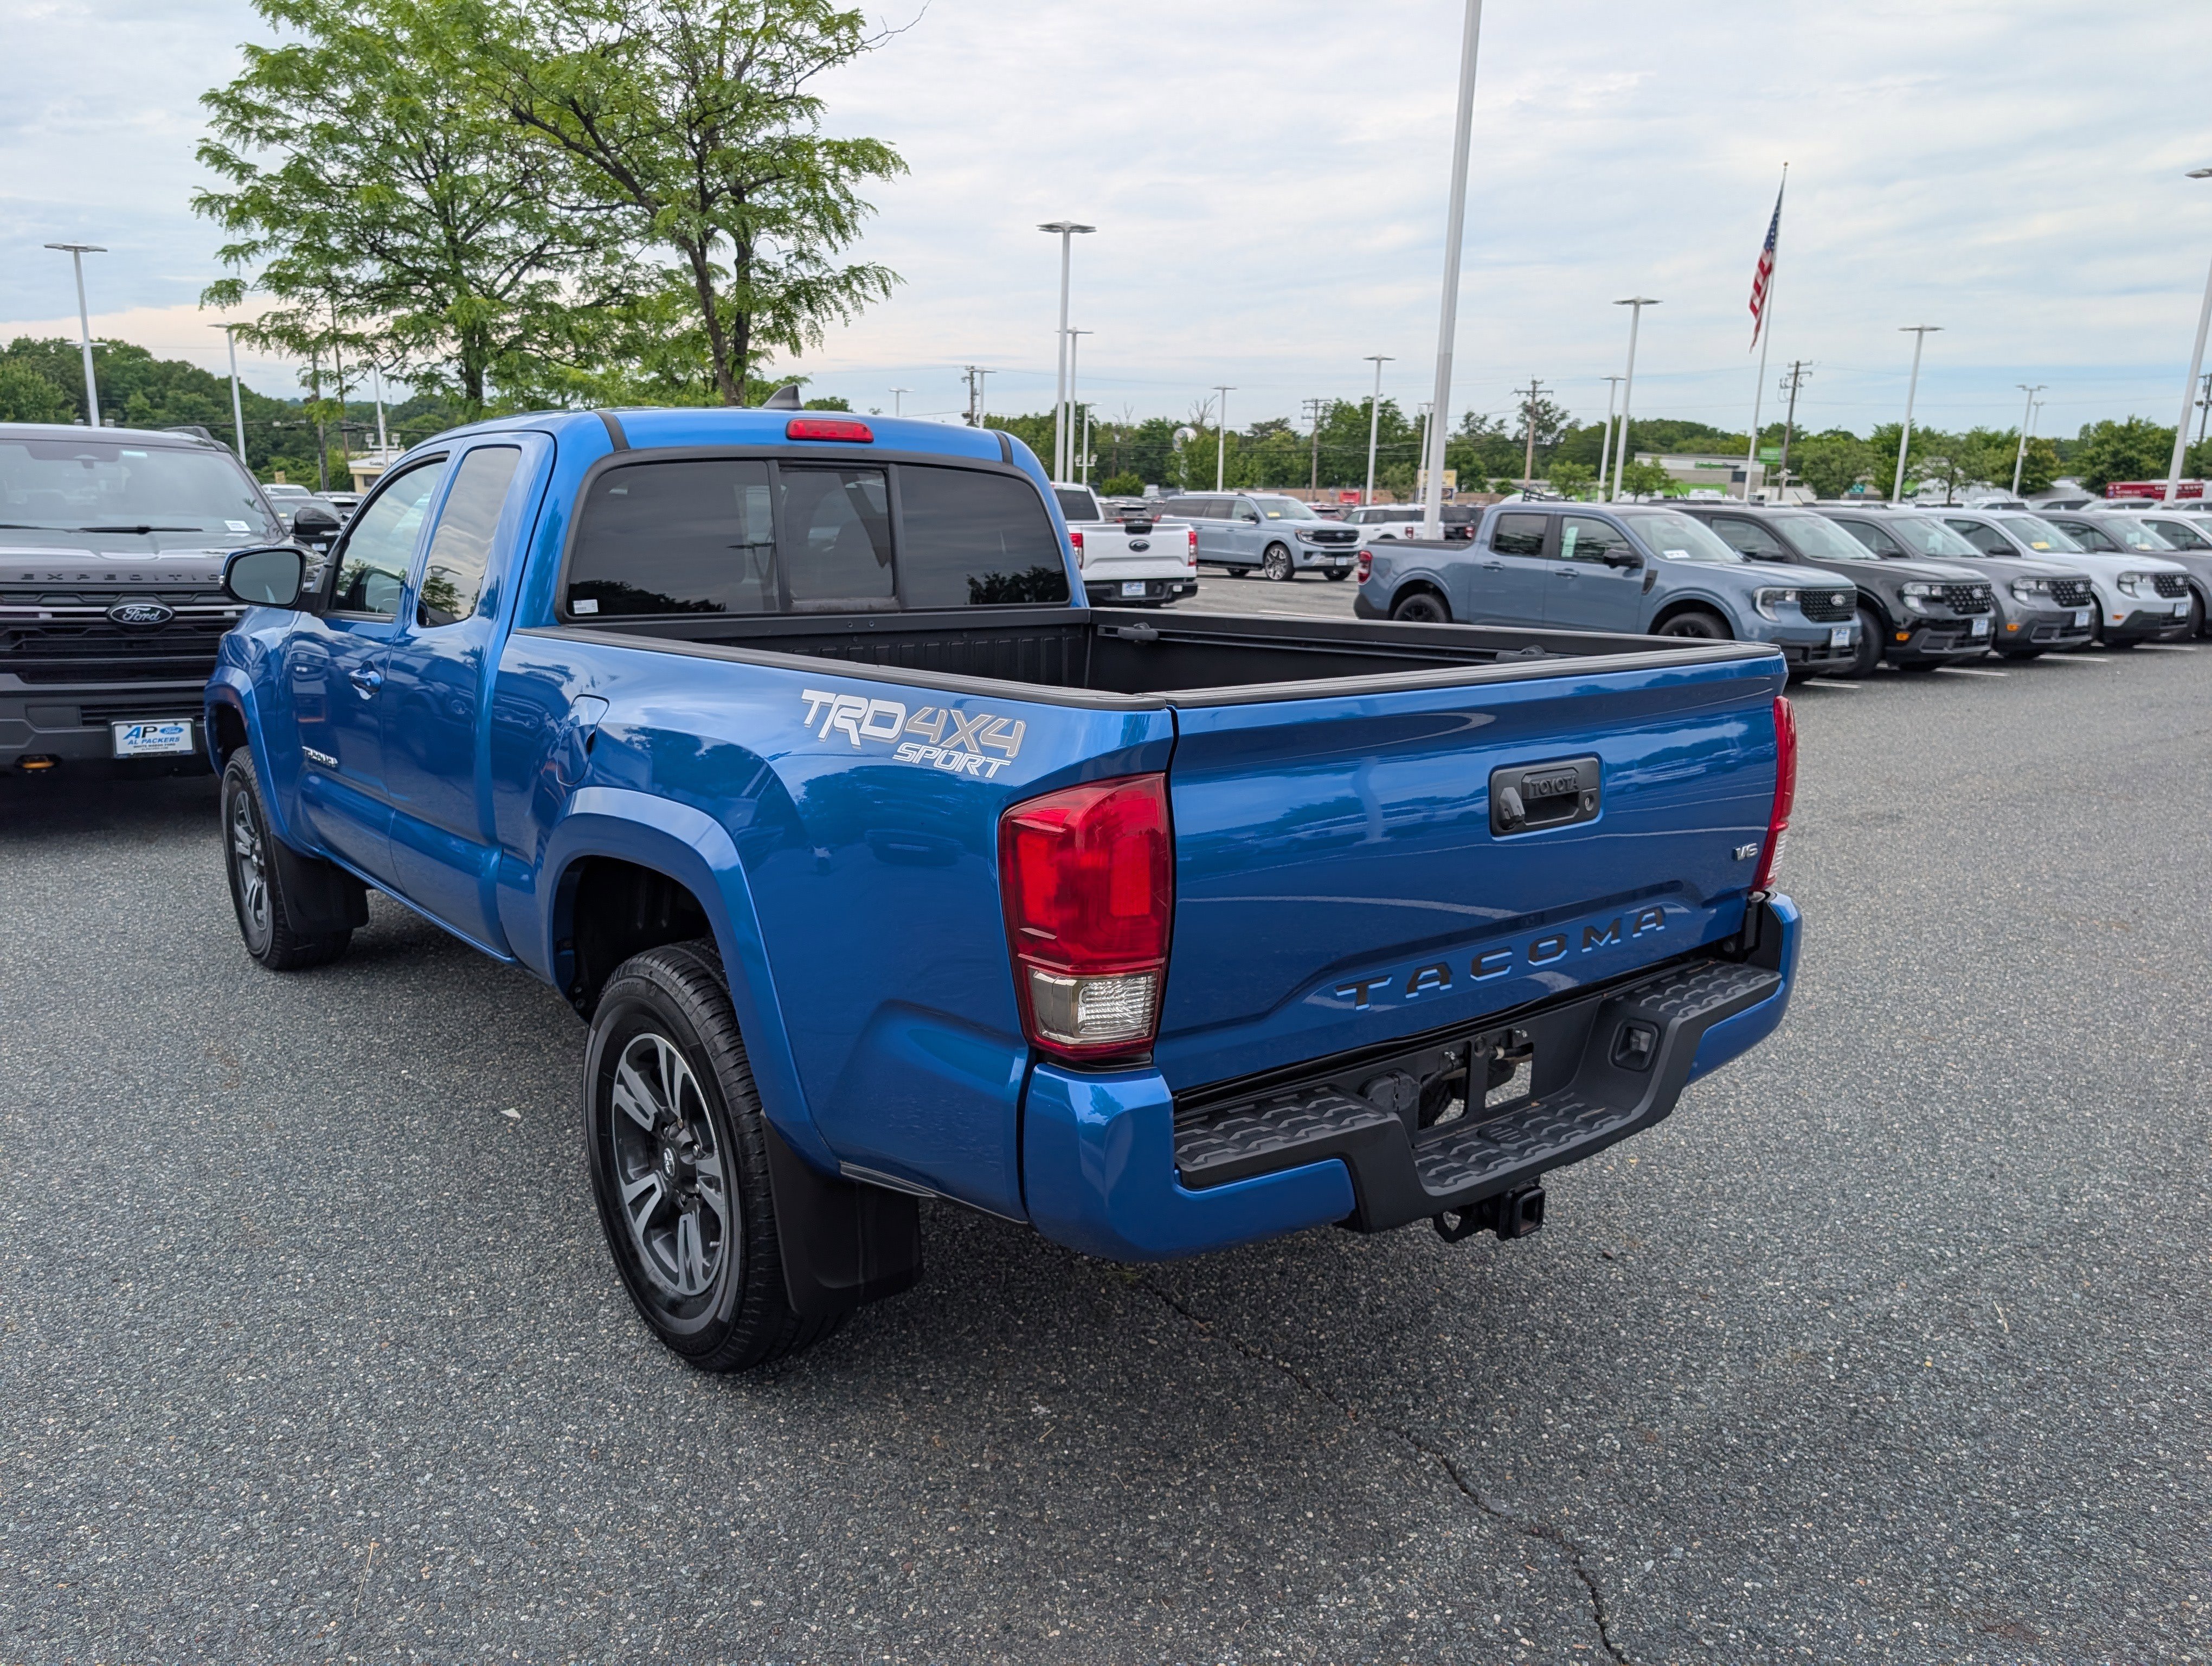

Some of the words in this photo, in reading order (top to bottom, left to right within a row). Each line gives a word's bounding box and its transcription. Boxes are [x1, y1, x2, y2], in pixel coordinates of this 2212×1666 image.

[122, 606, 160, 621] Ford
[801, 689, 907, 749] TRD
[123, 726, 158, 740] AP
[141, 736, 181, 745] PACKERS
[892, 742, 1012, 779] SPORT
[1530, 775, 1579, 796] TOYOTA
[1735, 842, 1758, 861] V6
[1335, 906, 1666, 1011] TACOMA
